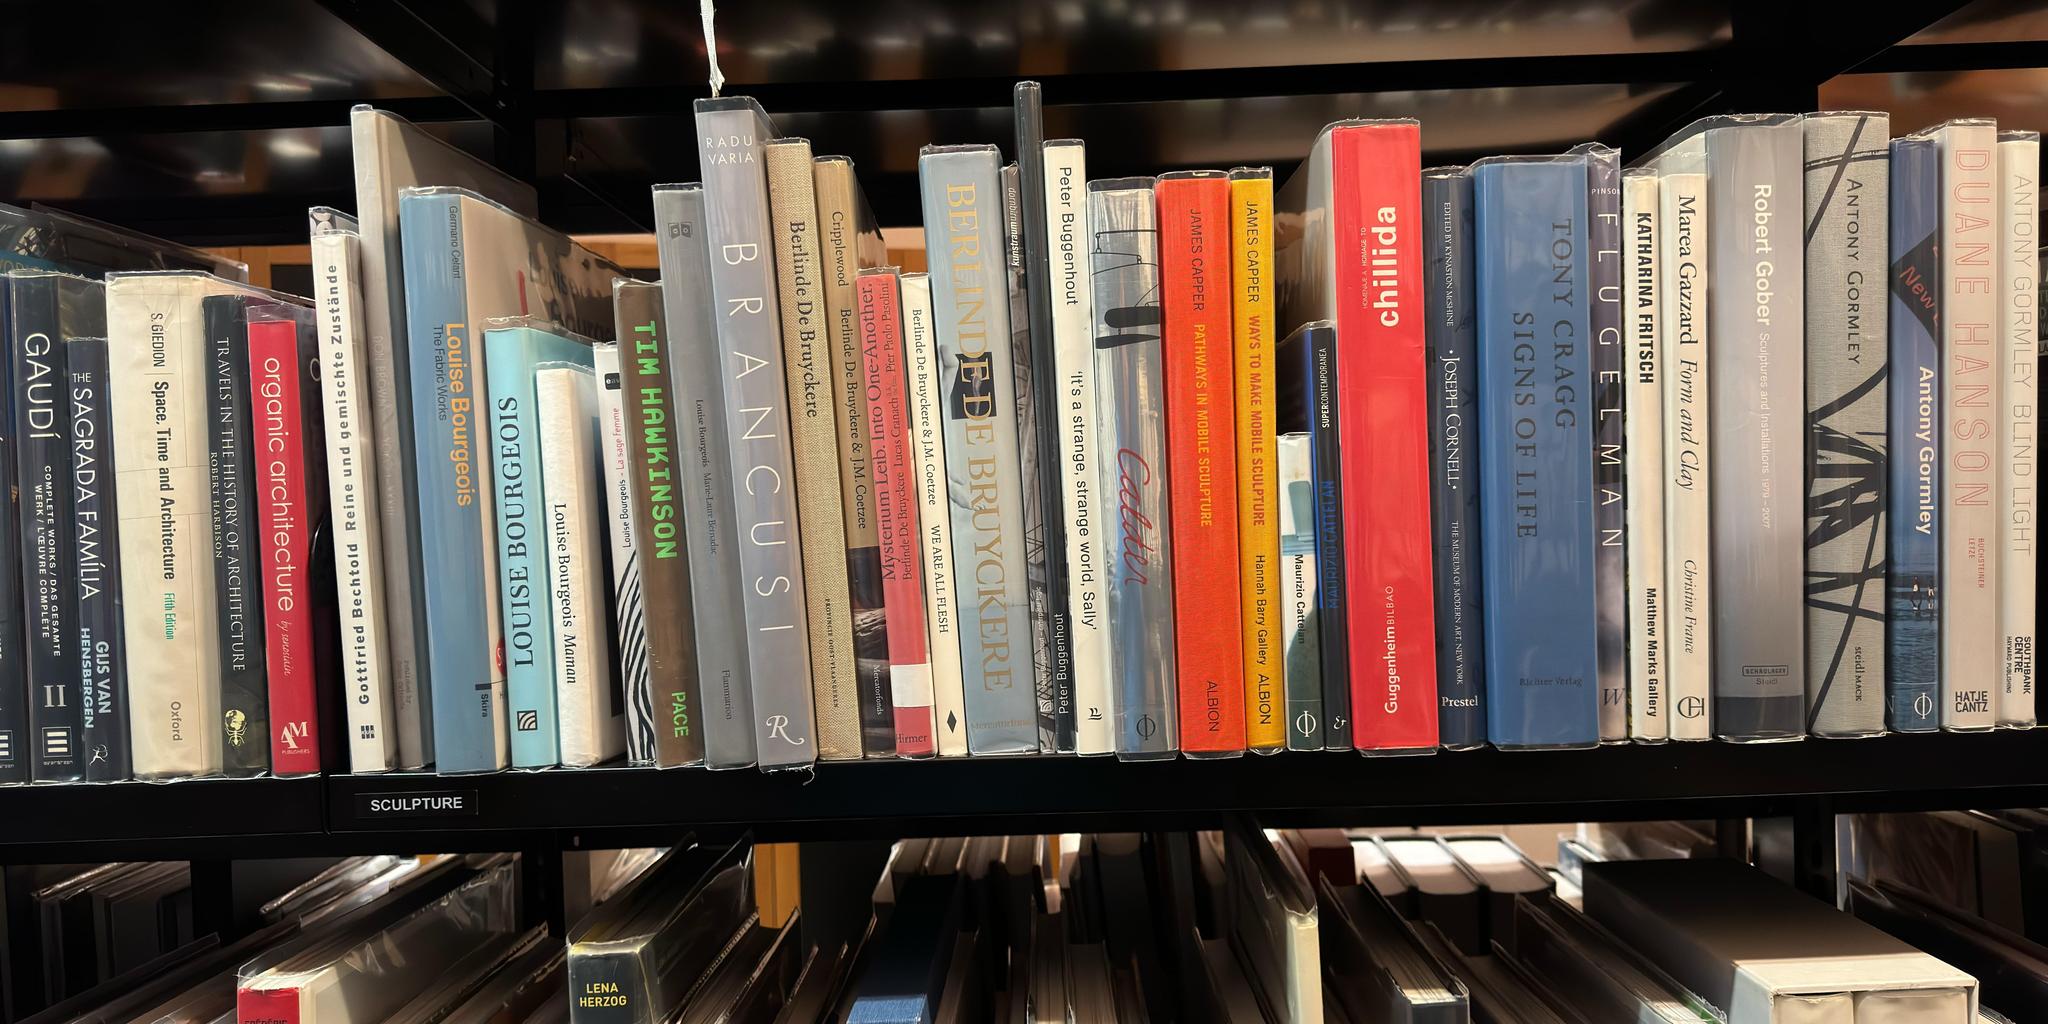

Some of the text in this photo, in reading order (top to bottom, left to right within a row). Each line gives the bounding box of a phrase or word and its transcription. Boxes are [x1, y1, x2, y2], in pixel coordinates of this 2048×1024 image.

[706, 135, 753, 148] RADU
[708, 152, 755, 164] VARIA
[1443, 202, 1451, 232] EDITED
[1591, 187, 1620, 195] PINSO
[830, 211, 849, 287] Cripplewood
[1010, 222, 1020, 267] kunstraum
[1060, 167, 1079, 305] Peter Buggenhout
[1371, 206, 1399, 327] chillida
[1444, 232, 1452, 240] BY
[1445, 241, 1454, 289] KYNASTON
[1846, 178, 1864, 364] ANTONY GORMLEY
[790, 221, 821, 419] Berlinde De Bruyckere
[1552, 218, 1576, 429] TONY CRAGG
[1637, 212, 1654, 384] KATHARINA FRITSCH
[1953, 150, 1990, 507] DUANE HANSON
[72, 372, 92, 383] THE
[150, 313, 165, 368] S. GIEDION
[433, 325, 447, 421] The Fabric Works
[1190, 209, 1212, 527] JAMES CAPPER PATHWAYS IN MOBILE SCULPTURE
[1246, 201, 1265, 527] JAMES CAPPER WAYS TO MAKE MOBILE SCULPTURE
[1675, 194, 1699, 491] Marea Gazzard Form and Clay
[2012, 175, 2033, 556] ANTONY GORMLEY BLIND LIGHT
[25, 333, 61, 439] GAUDÍ
[445, 323, 476, 506] Louise Bourgeois
[913, 309, 936, 505] Berlinde De Bruyckere & J.M. Coetzee
[1319, 347, 1330, 428] SUPERCONTEMPORANEA
[1597, 213, 1623, 547] FLUGELMAN
[634, 320, 678, 559] TIM HAWKINSON
[722, 243, 794, 632] BRANCUSI
[860, 283, 901, 581] Mysterium Leib. Into One-Another.
[1512, 312, 1538, 538] SIGNS OF LIFE
[44, 465, 55, 525] COMPLETE
[73, 388, 105, 600] SAGRADA FAMÍLIA
[153, 381, 177, 580] Space, Time and Architecture
[209, 452, 222, 559] ROBERT HARBISON
[325, 265, 370, 705] Gottfried Bechtold Reine und gemischte Zustände
[614, 431, 631, 548] Louise Bourgeois La sage
[1117, 447, 1156, 586] Calder
[48, 529, 58, 567] WORKS
[498, 397, 534, 667] LOUISE BOURGEOIS
[1452, 538, 1460, 574] MUSEUM
[50, 579, 58, 602] DAS
[554, 503, 577, 684] Louise Bourgeois Maman
[931, 525, 949, 633] WE ARE ALL FLESH
[1294, 554, 1303, 599] Maurizio
[1453, 576, 1460, 587] OF
[1453, 588, 1461, 624] MODERN
[1684, 559, 1697, 654] Christine France
[51, 605, 61, 657] GESAMTE
[163, 592, 177, 640] Fifth Edition
[1255, 555, 1271, 725] Hannah Barry Gallery ALBION
[1455, 643, 1463, 661] NEW
[1646, 588, 1658, 717] Matthew Marks Gallery
[2014, 636, 2024, 674] CENTRE
[81, 628, 94, 728] HENSBERGEN
[95, 641, 111, 714] GIJS VAN
[722, 669, 733, 720] Flammarion
[872, 664, 884, 716] Mercatorfonds
[1054, 612, 1069, 714] Peter Buggenhout
[1441, 695, 1479, 707] Prestel
[1456, 661, 1464, 685] YORK
[1955, 690, 1988, 702] HATJE
[2023, 636, 2032, 694] SOUTHBANK
[170, 701, 183, 741] Oxford
[671, 691, 689, 738] PACE
[1206, 680, 1219, 732] ALBION
[1955, 702, 1988, 712] CANTZ
[371, 797, 463, 813] SCULPTURE
[579, 996, 627, 1008] HERZOG
[585, 982, 619, 994] LENA
